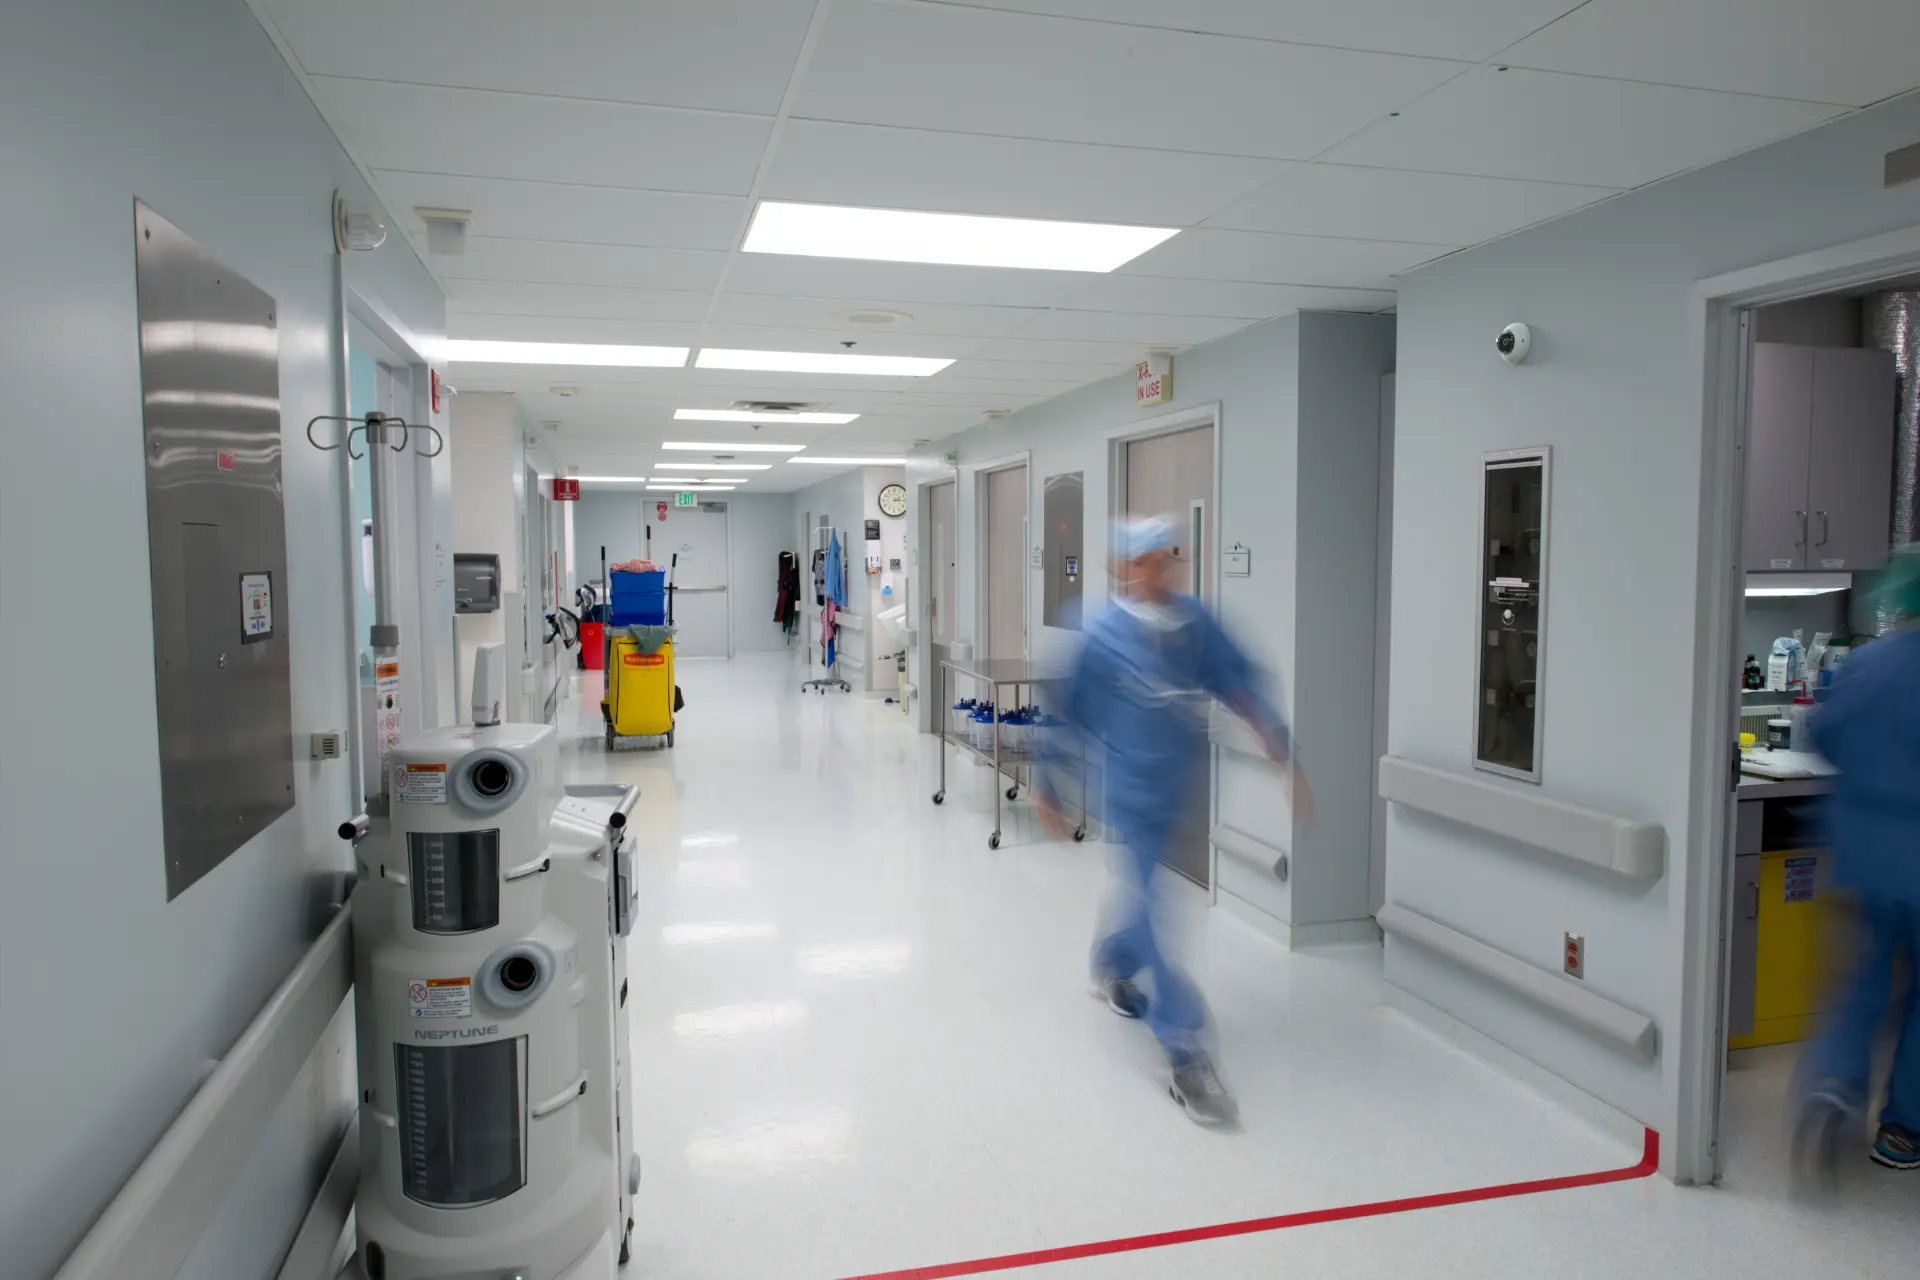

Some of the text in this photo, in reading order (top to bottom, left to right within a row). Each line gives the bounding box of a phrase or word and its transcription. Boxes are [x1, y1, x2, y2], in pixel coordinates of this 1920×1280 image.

[1137, 380, 1160, 401] IN USE
[678, 493, 694, 505] EXIT
[414, 1025, 499, 1039] NEPTUNE
